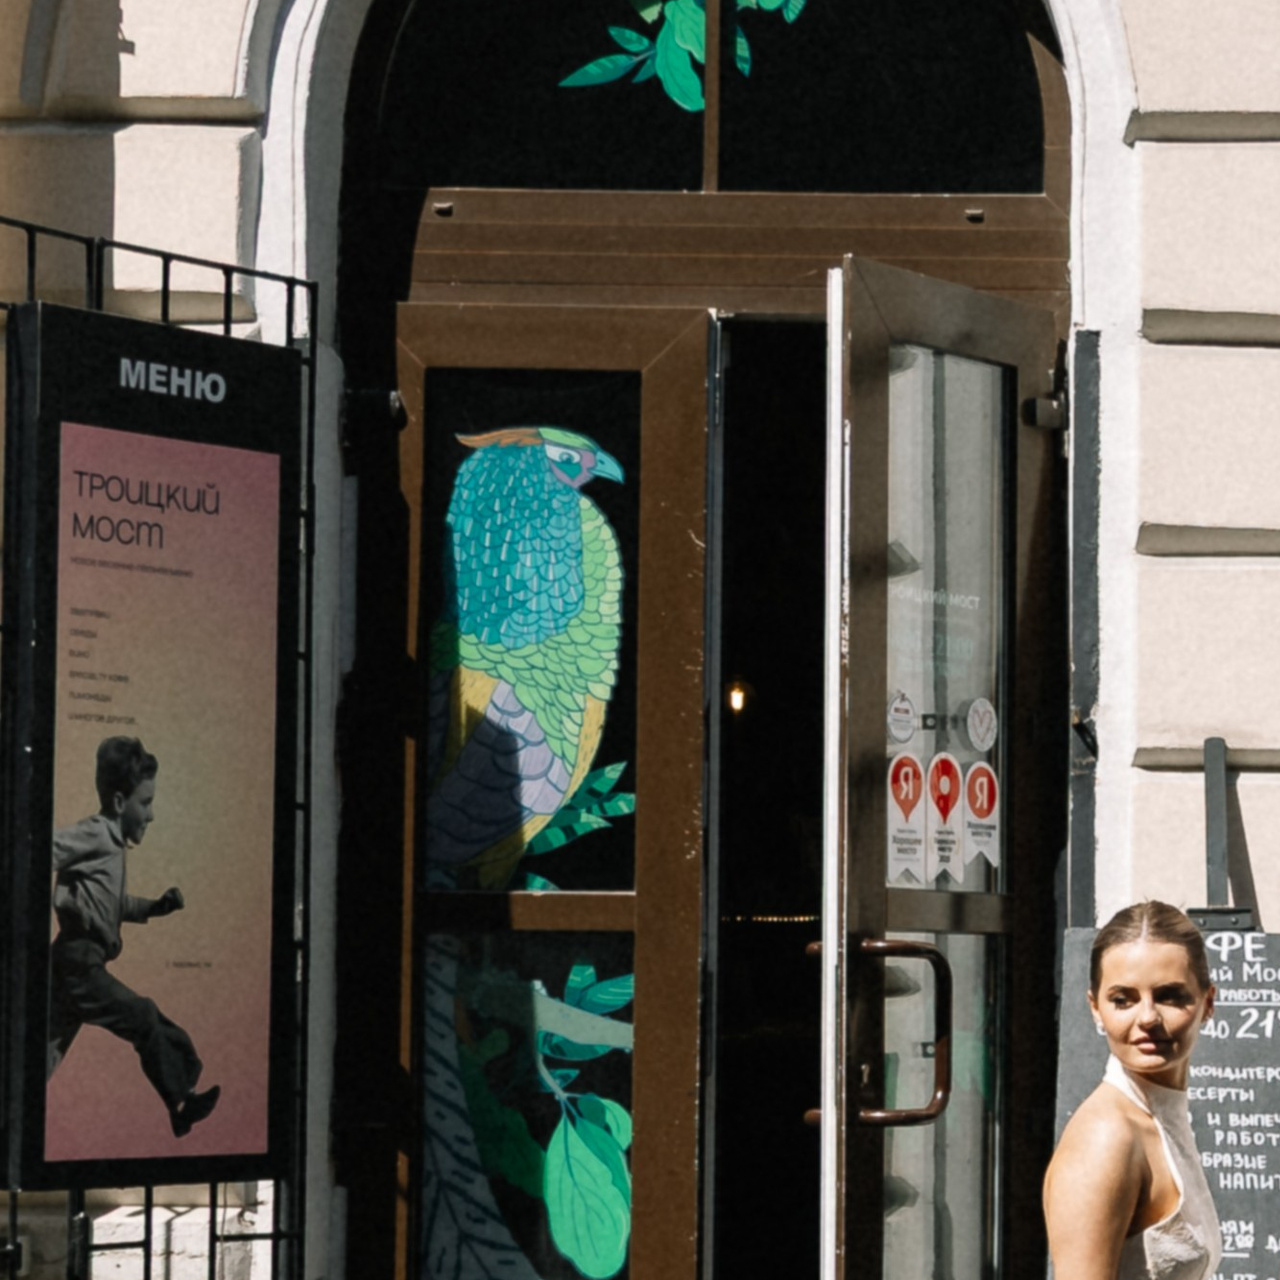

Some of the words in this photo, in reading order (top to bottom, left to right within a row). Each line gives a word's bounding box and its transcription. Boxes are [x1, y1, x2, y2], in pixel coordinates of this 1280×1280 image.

[120, 357, 227, 404] МЕНЮ
[900, 766, 913, 800] Я
[974, 776, 988, 810] Я
[1205, 931, 1267, 962] ФЕ
[1187, 1087, 1255, 1103] ЕСЕРТЫ
